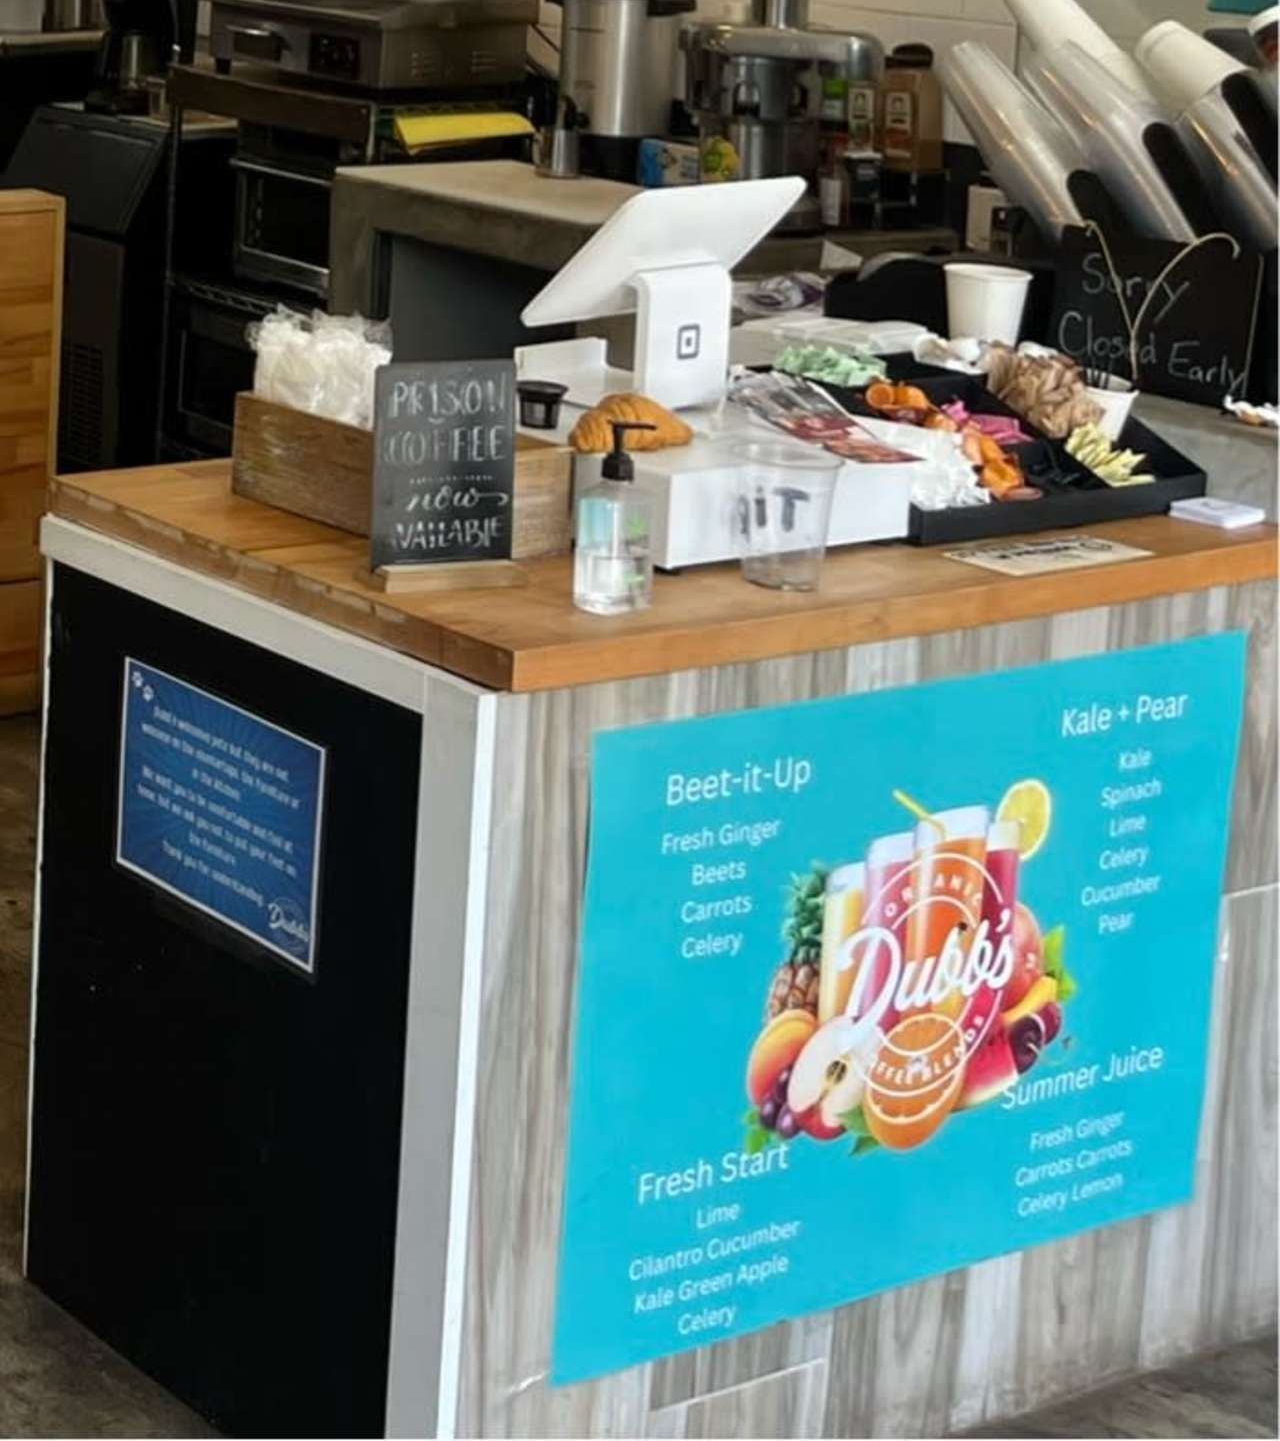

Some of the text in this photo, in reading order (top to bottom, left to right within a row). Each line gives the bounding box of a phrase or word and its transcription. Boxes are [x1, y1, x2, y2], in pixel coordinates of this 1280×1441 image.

[1058, 311, 1247, 398] Closd Early
[385, 425, 506, 464] COFFEE
[1061, 692, 1188, 737] Kale + Pear
[1119, 747, 1152, 771] Kale
[666, 756, 812, 806] Beet-it-Up
[1101, 778, 1162, 809] Spinach
[661, 819, 781, 855] Fresh Ginger
[1109, 813, 1147, 837] Lime
[691, 861, 747, 886] Beets
[1099, 846, 1149, 870] Celery
[680, 895, 752, 923] Carrots
[1081, 875, 1161, 906] Cucumber
[1098, 910, 1134, 935] Pear
[681, 932, 744, 958] Celery
[835, 907, 1014, 1027] Dubb's
[1000, 1045, 1164, 1110] Summer Juice
[1029, 1111, 1125, 1153] Fresh Ginger
[637, 1143, 789, 1204] Fresh Start
[1015, 1139, 1132, 1188] Carrots Carrots
[1017, 1172, 1123, 1218] Celery Lemon
[696, 1202, 742, 1229] Lime
[628, 1220, 801, 1281] Cilantro Cucumber
[633, 1254, 789, 1314] Kale Green Apple
[677, 1305, 737, 1335] Celery
